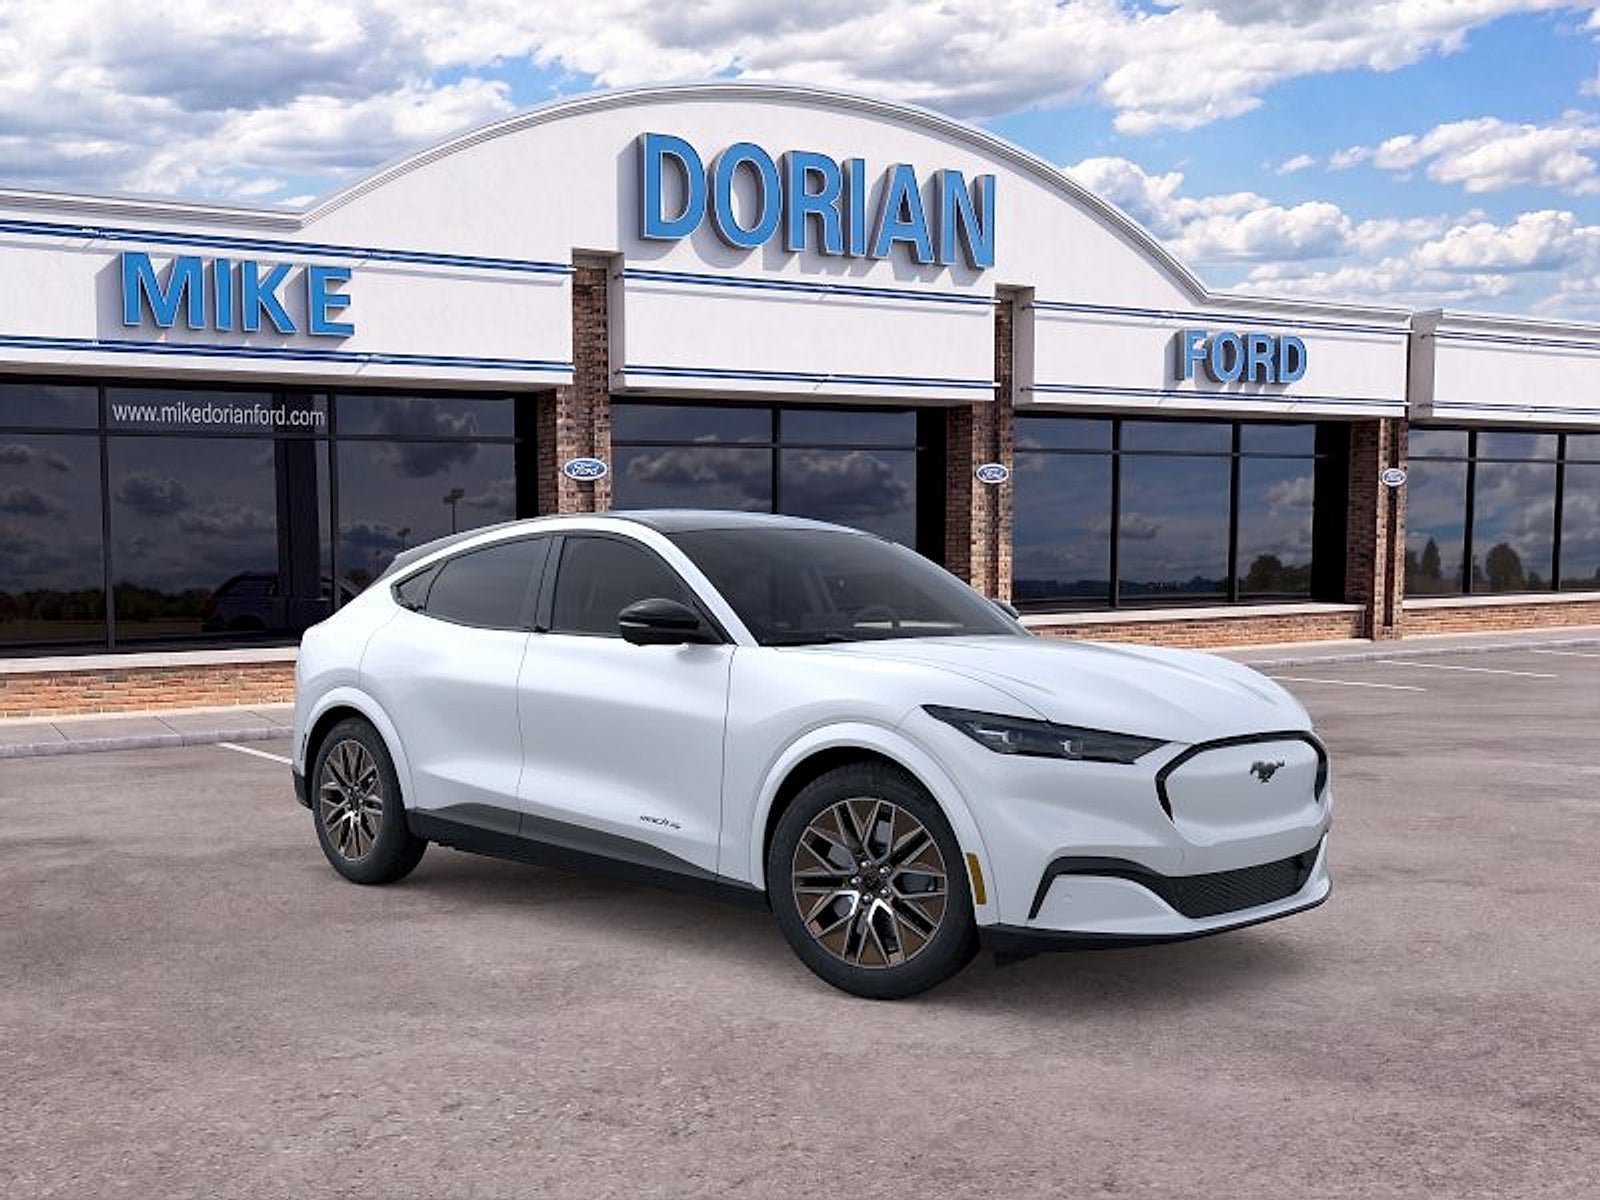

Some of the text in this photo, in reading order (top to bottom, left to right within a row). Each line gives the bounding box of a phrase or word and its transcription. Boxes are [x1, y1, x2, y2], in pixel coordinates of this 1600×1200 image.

[641, 132, 995, 268] DORIAN
[122, 251, 355, 337] MIKE
[1178, 328, 1308, 383] FORD
[112, 402, 325, 426] www.mikedorianford.com
